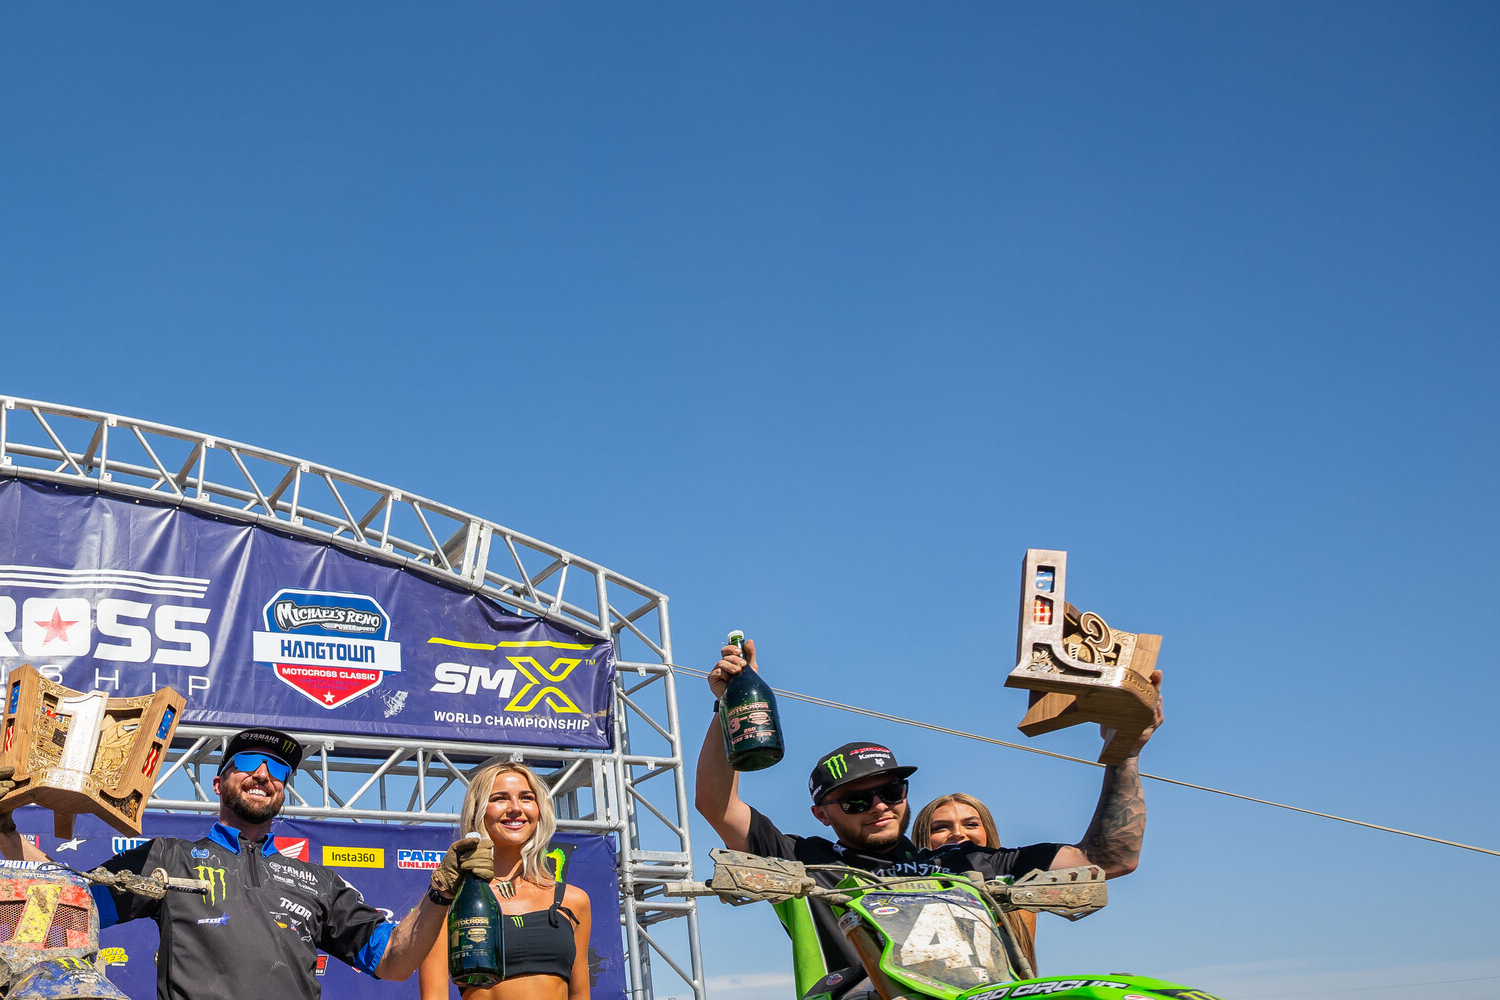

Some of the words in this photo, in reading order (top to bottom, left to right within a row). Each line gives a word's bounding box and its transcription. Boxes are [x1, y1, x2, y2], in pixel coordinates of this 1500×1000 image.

[280, 639, 376, 663] HANGTOWN
[282, 667, 338, 679] MOTOCROSS
[340, 670, 376, 681] CLASSIC
[430, 656, 582, 713] SMX
[434, 710, 481, 725] WORLD
[484, 713, 590, 731] CHAMPIONSHIP
[250, 732, 280, 744] YAMAHA
[331, 851, 376, 863] Insta360
[399, 850, 447, 862] PART
[399, 861, 441, 869] UNLIMI
[281, 865, 319, 884] YAMAHA
[280, 897, 312, 921] THOR
[1010, 980, 1130, 999] CIRCUIT
